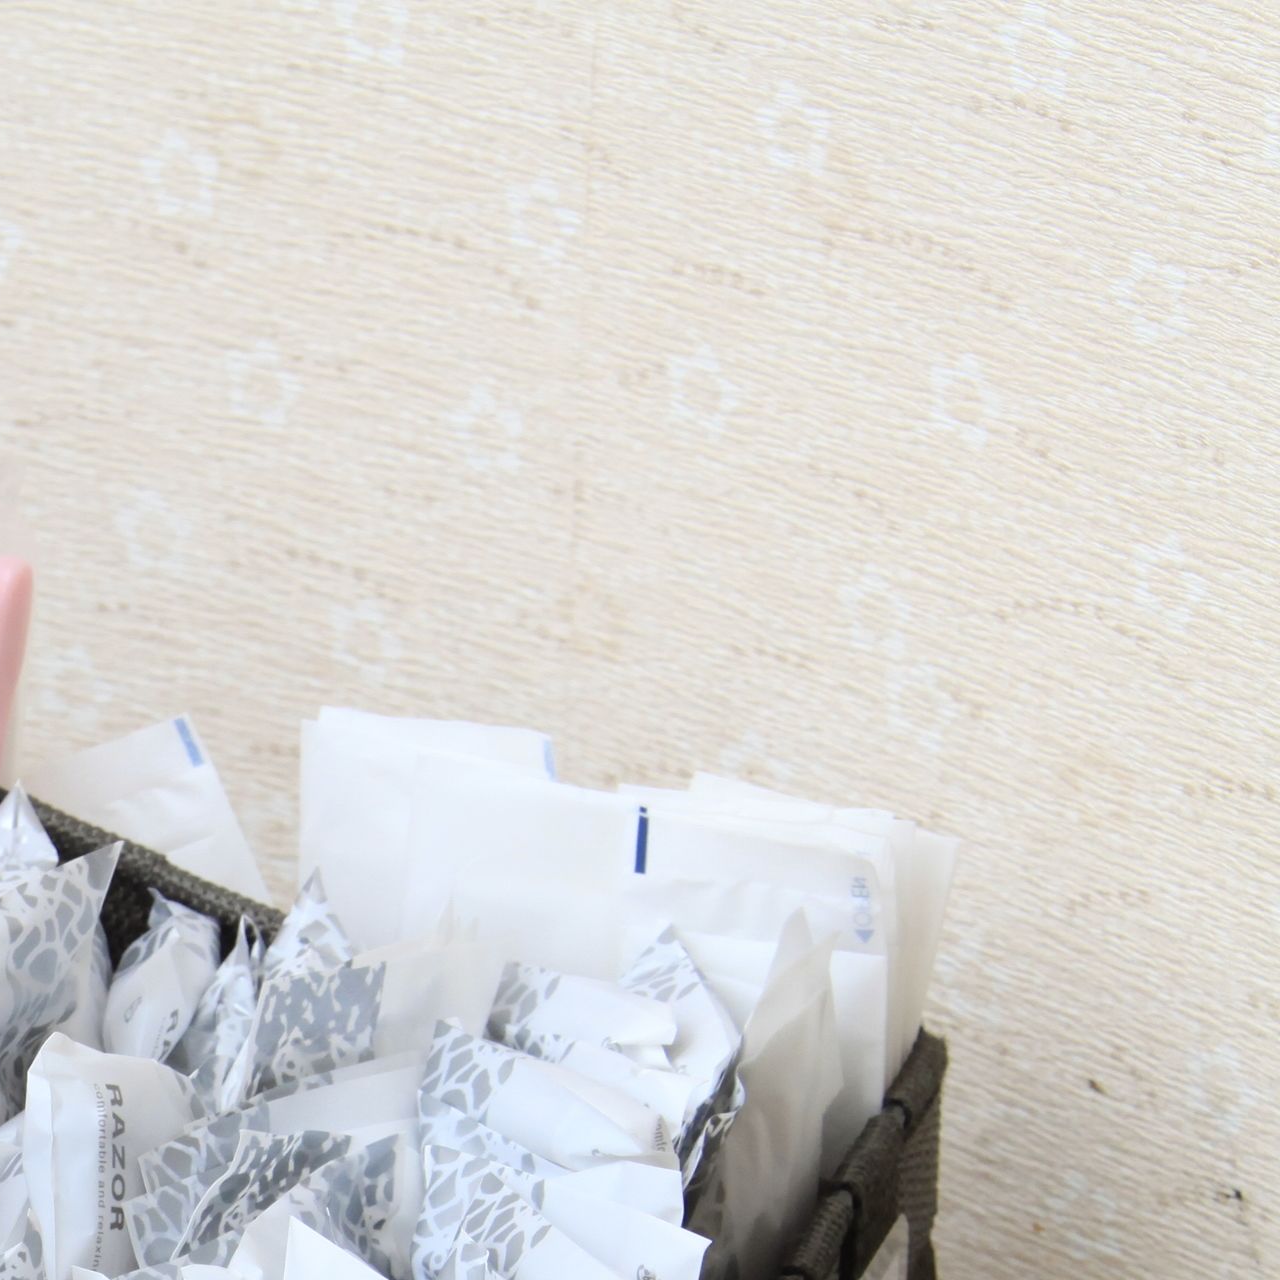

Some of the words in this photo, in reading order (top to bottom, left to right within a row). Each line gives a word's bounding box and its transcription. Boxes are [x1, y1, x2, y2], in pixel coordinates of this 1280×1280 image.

[94, 1083, 107, 1172] comfortable
[105, 1083, 126, 1231] RAZOR
[97, 1180, 107, 1209] and
[91, 1215, 105, 1272] relaxin
